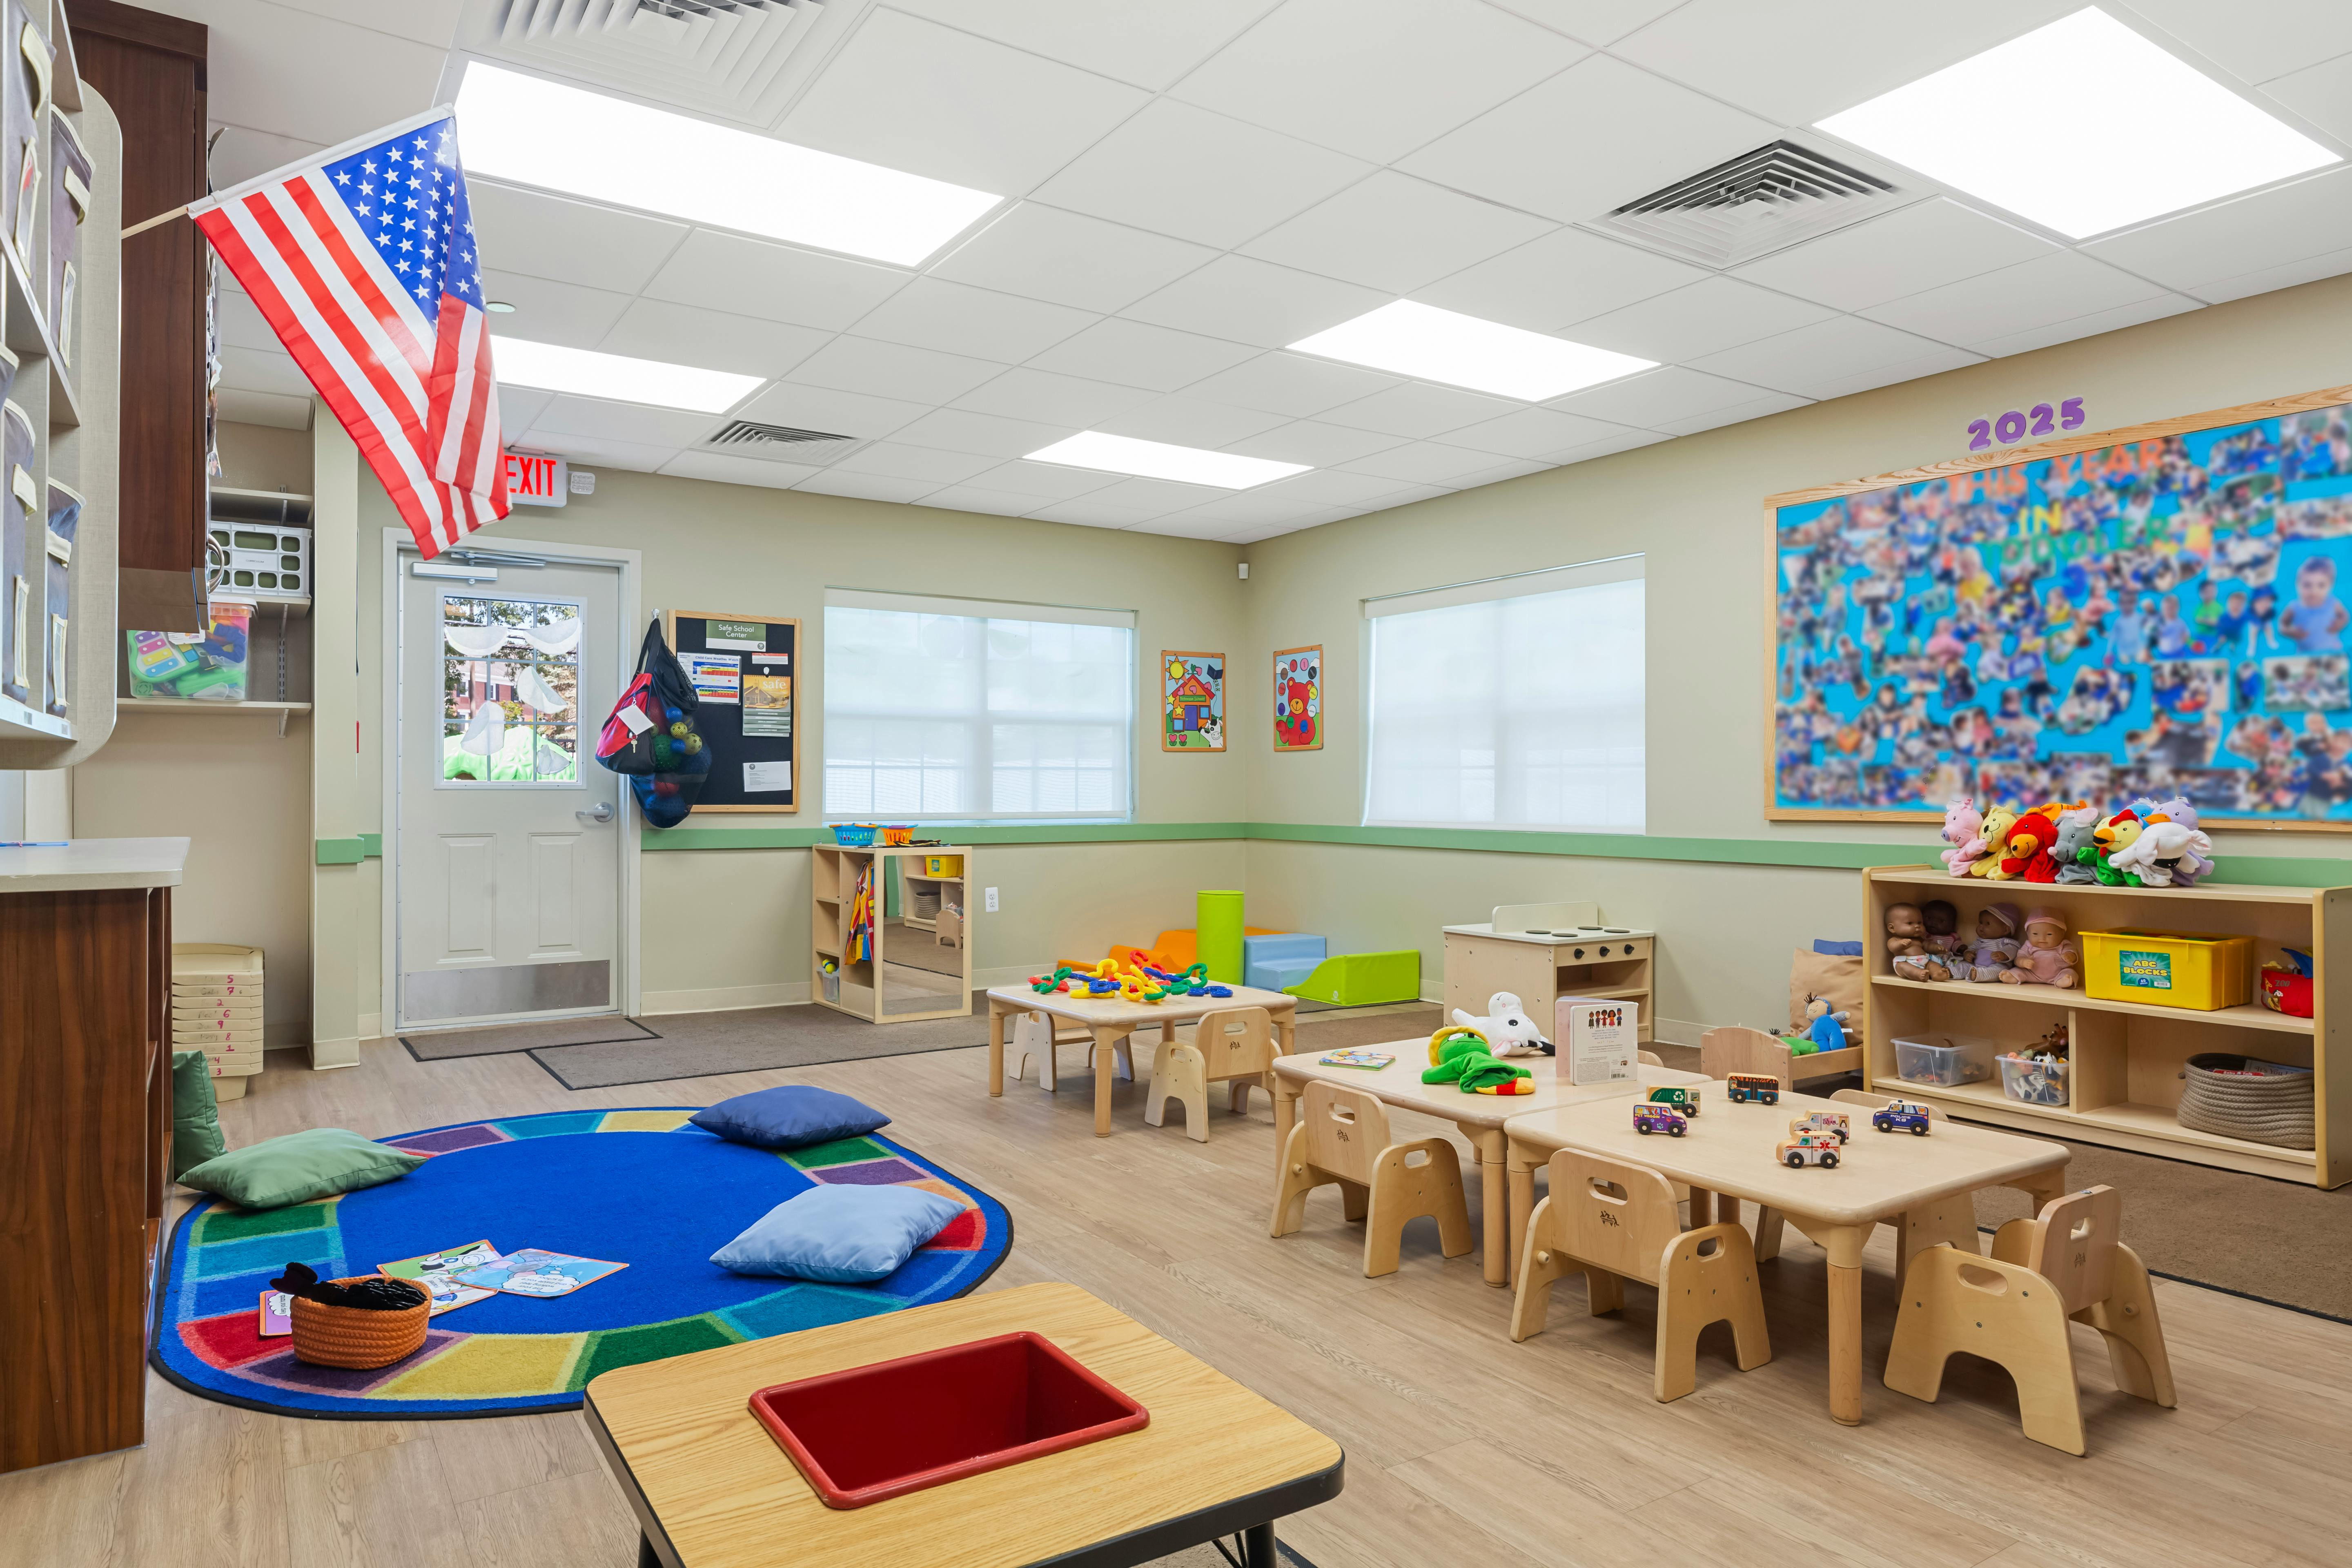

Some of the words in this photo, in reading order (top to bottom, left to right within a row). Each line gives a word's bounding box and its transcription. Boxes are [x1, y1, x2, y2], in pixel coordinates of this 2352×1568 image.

[1968, 397, 2085, 451] 2025
[2052, 438, 2167, 483] YEAR
[505, 455, 556, 497] EXIT
[2019, 501, 2062, 535] IN
[763, 679, 787, 689] safe
[2123, 967, 2168, 976] BLOCKS
[227, 975, 234, 983] 5
[227, 987, 234, 995] 7
[223, 1009, 231, 1018] 6
[218, 1020, 224, 1029] 9
[225, 1032, 231, 1040] 8
